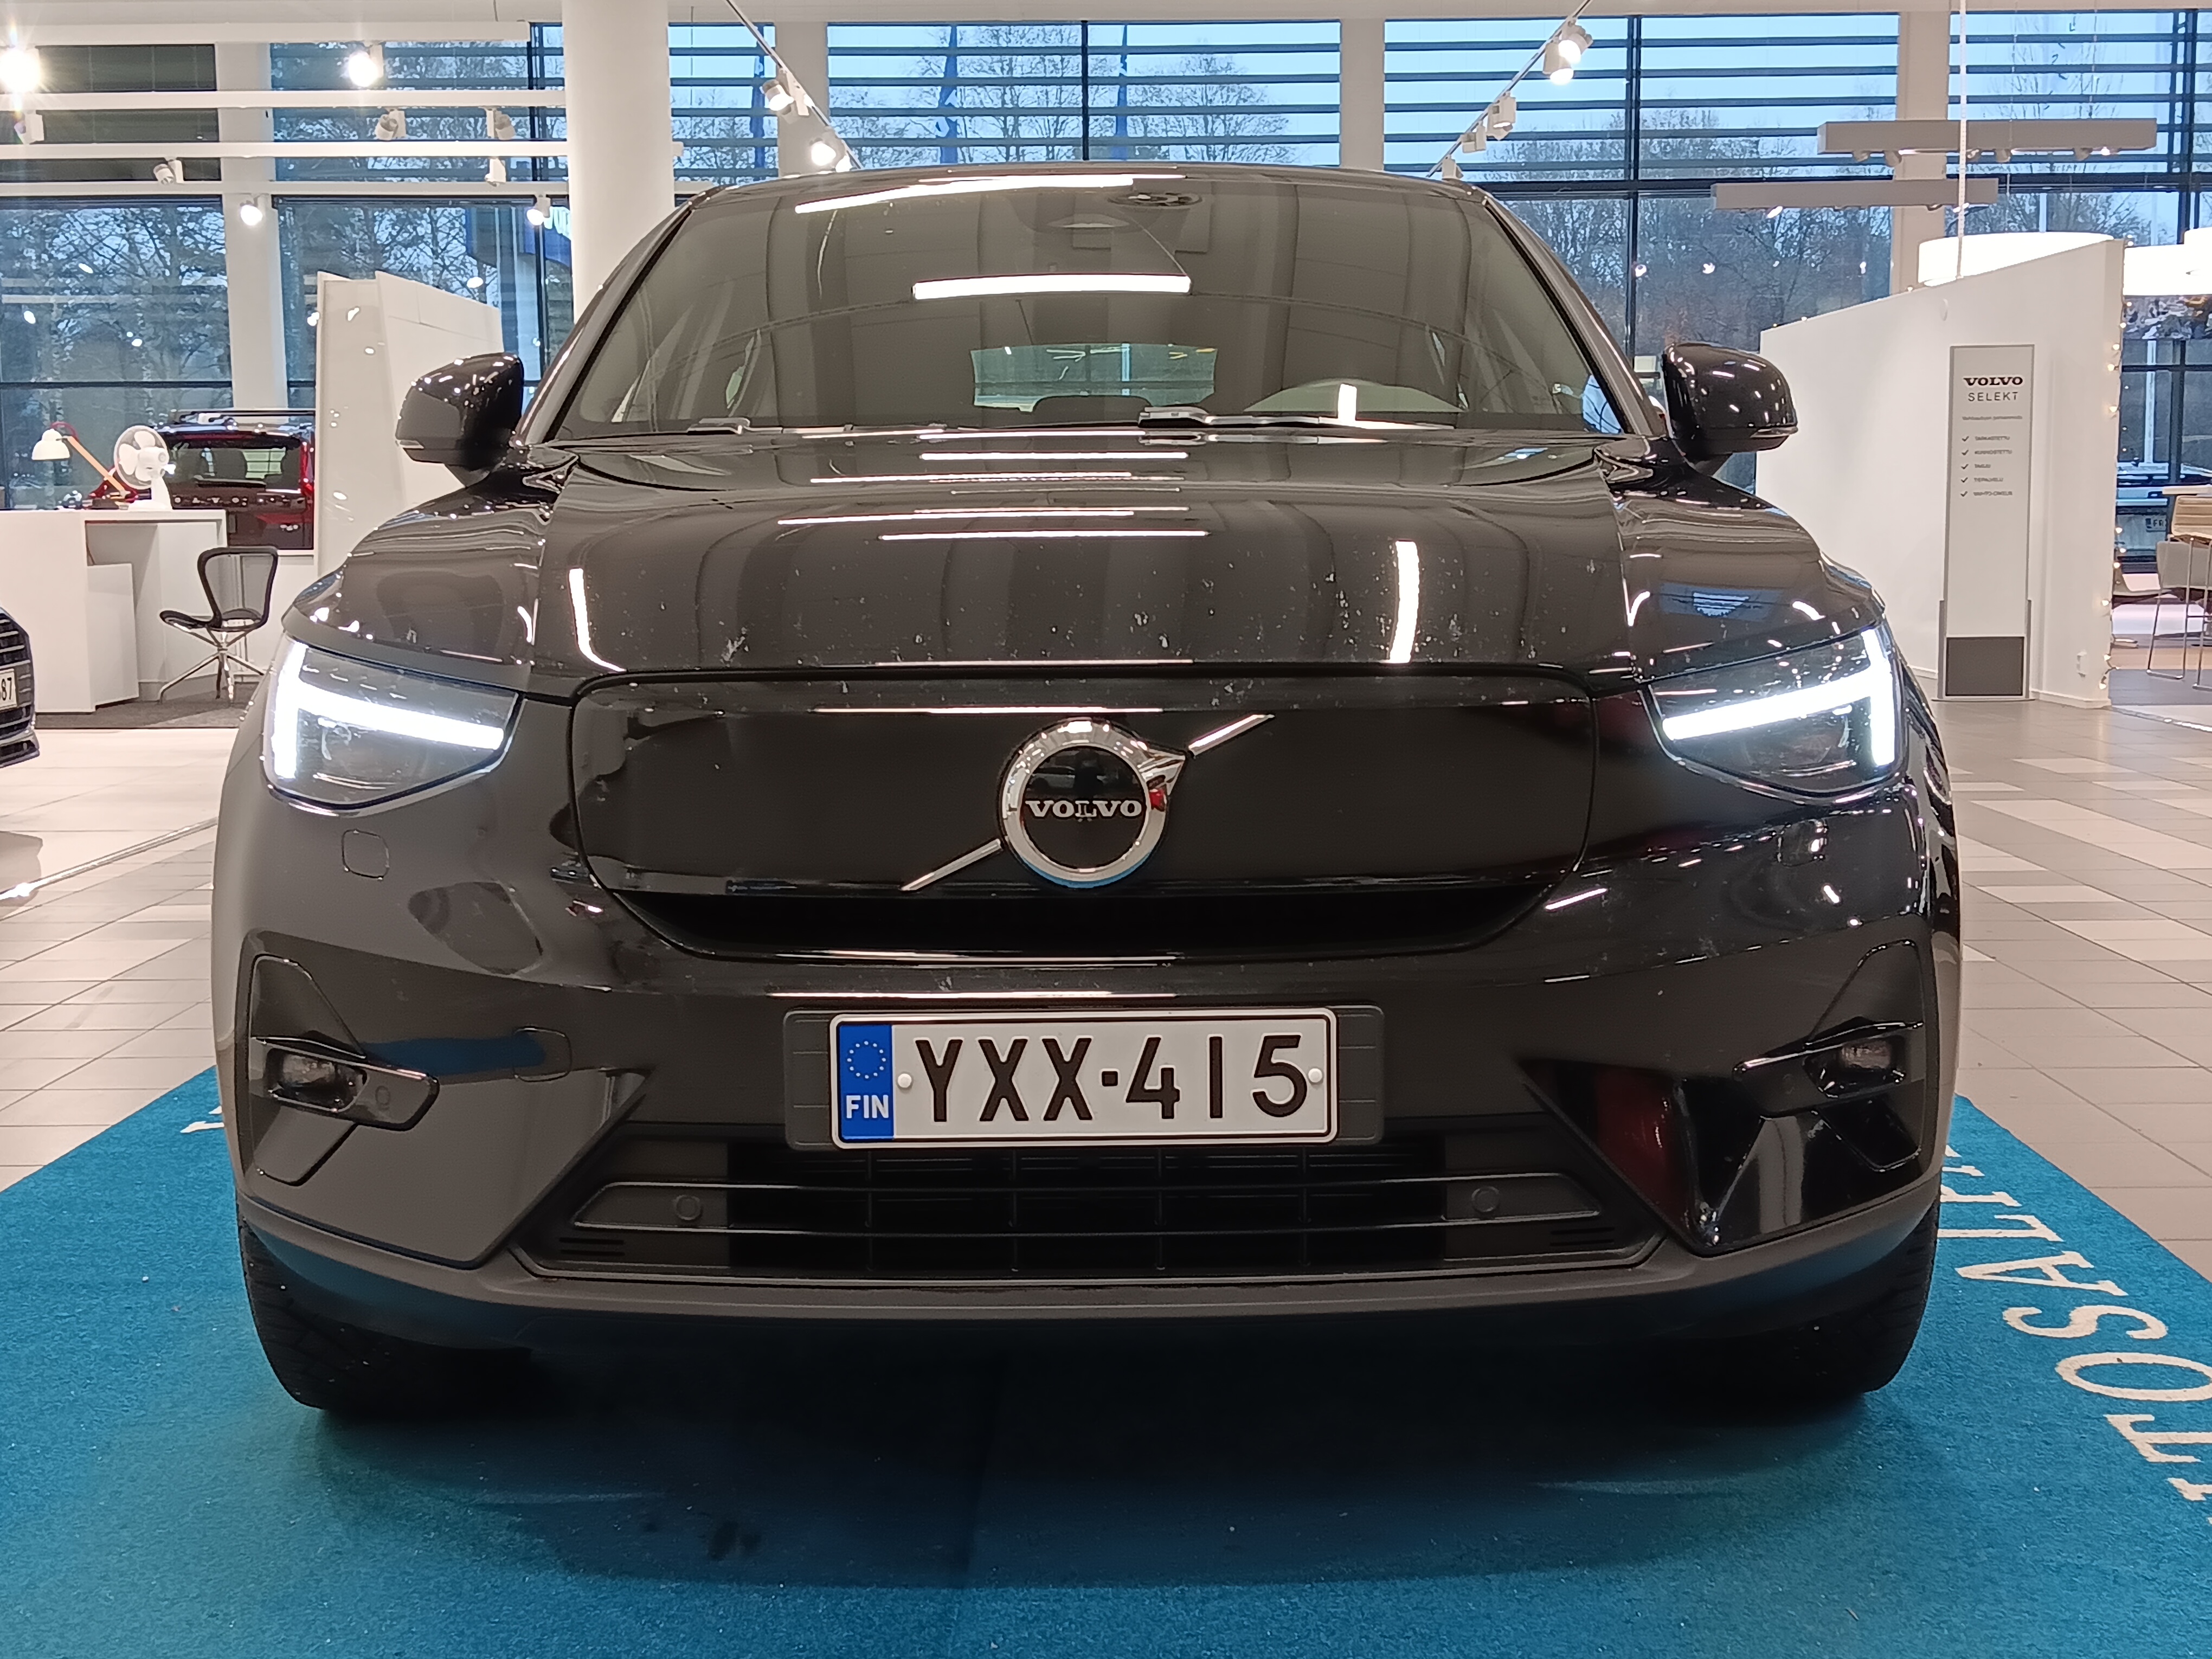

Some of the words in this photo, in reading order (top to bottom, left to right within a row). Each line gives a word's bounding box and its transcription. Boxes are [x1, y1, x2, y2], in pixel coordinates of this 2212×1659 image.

[1963, 376, 2023, 386] VOLVO
[1968, 391, 2018, 402] SELEKT
[0, 677, 12, 701] 87
[1025, 800, 1142, 818] VOLVO
[915, 1034, 1308, 1122] YXX-415
[846, 1094, 889, 1119] FIN
